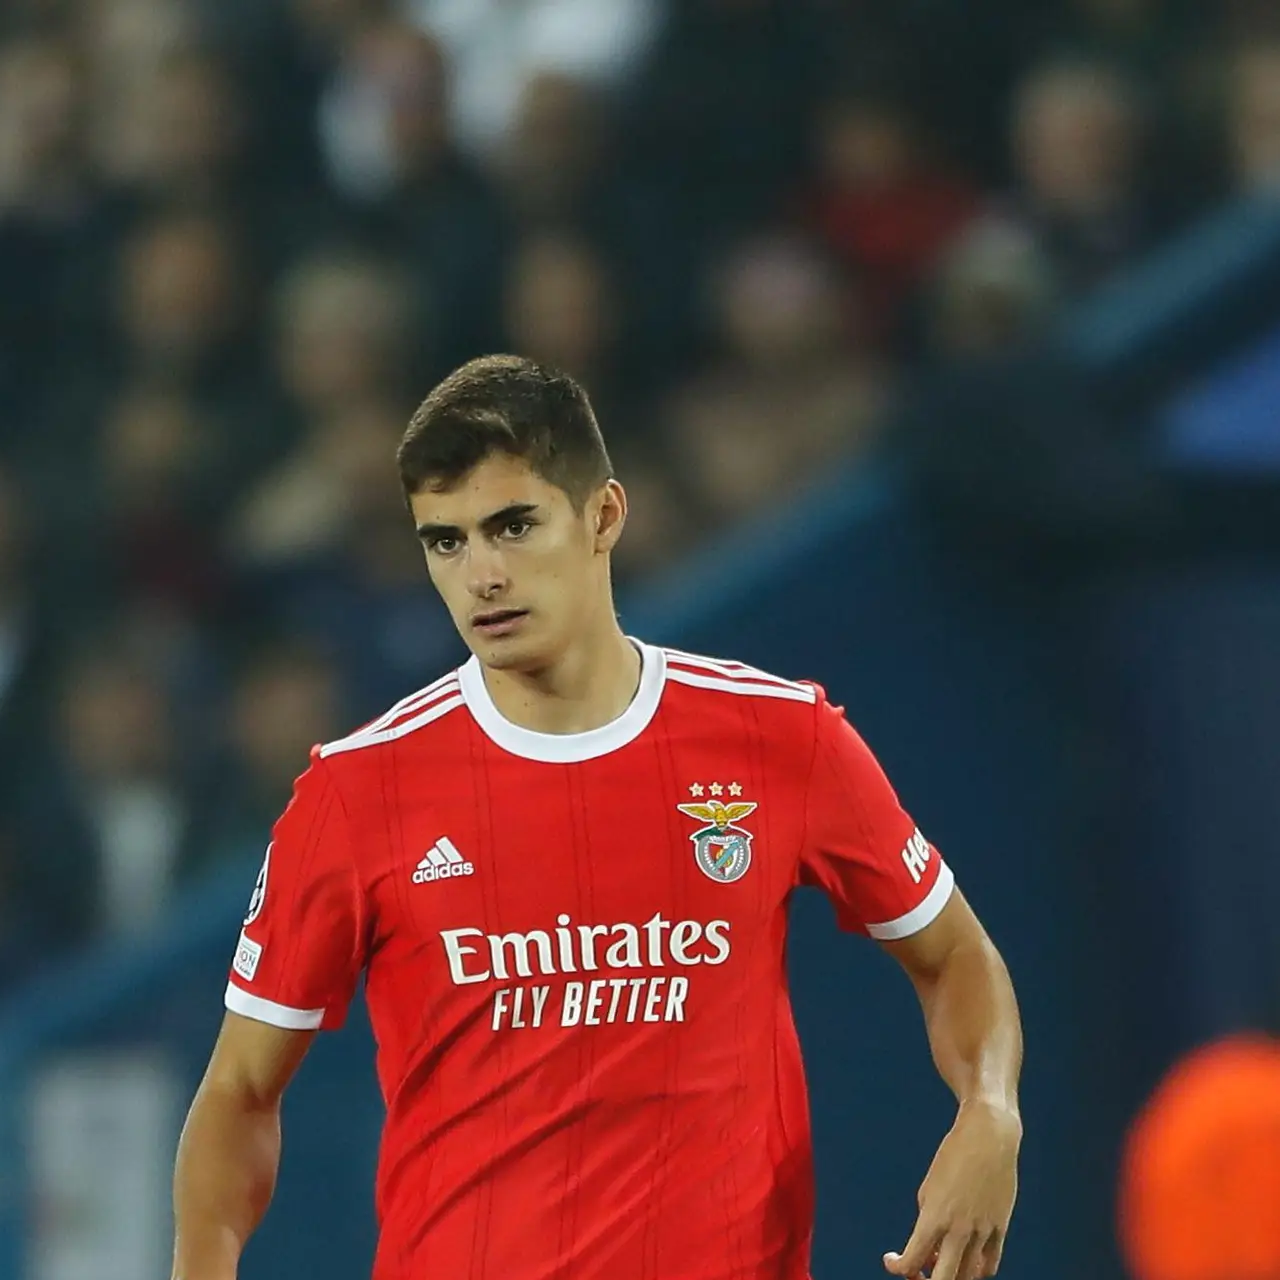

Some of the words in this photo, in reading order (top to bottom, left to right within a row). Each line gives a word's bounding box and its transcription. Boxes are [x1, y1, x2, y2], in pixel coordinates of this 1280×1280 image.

[412, 862, 475, 884] adidas
[439, 912, 731, 985] Emirates
[492, 985, 550, 1031] FLY
[560, 976, 689, 1027] BETTER
